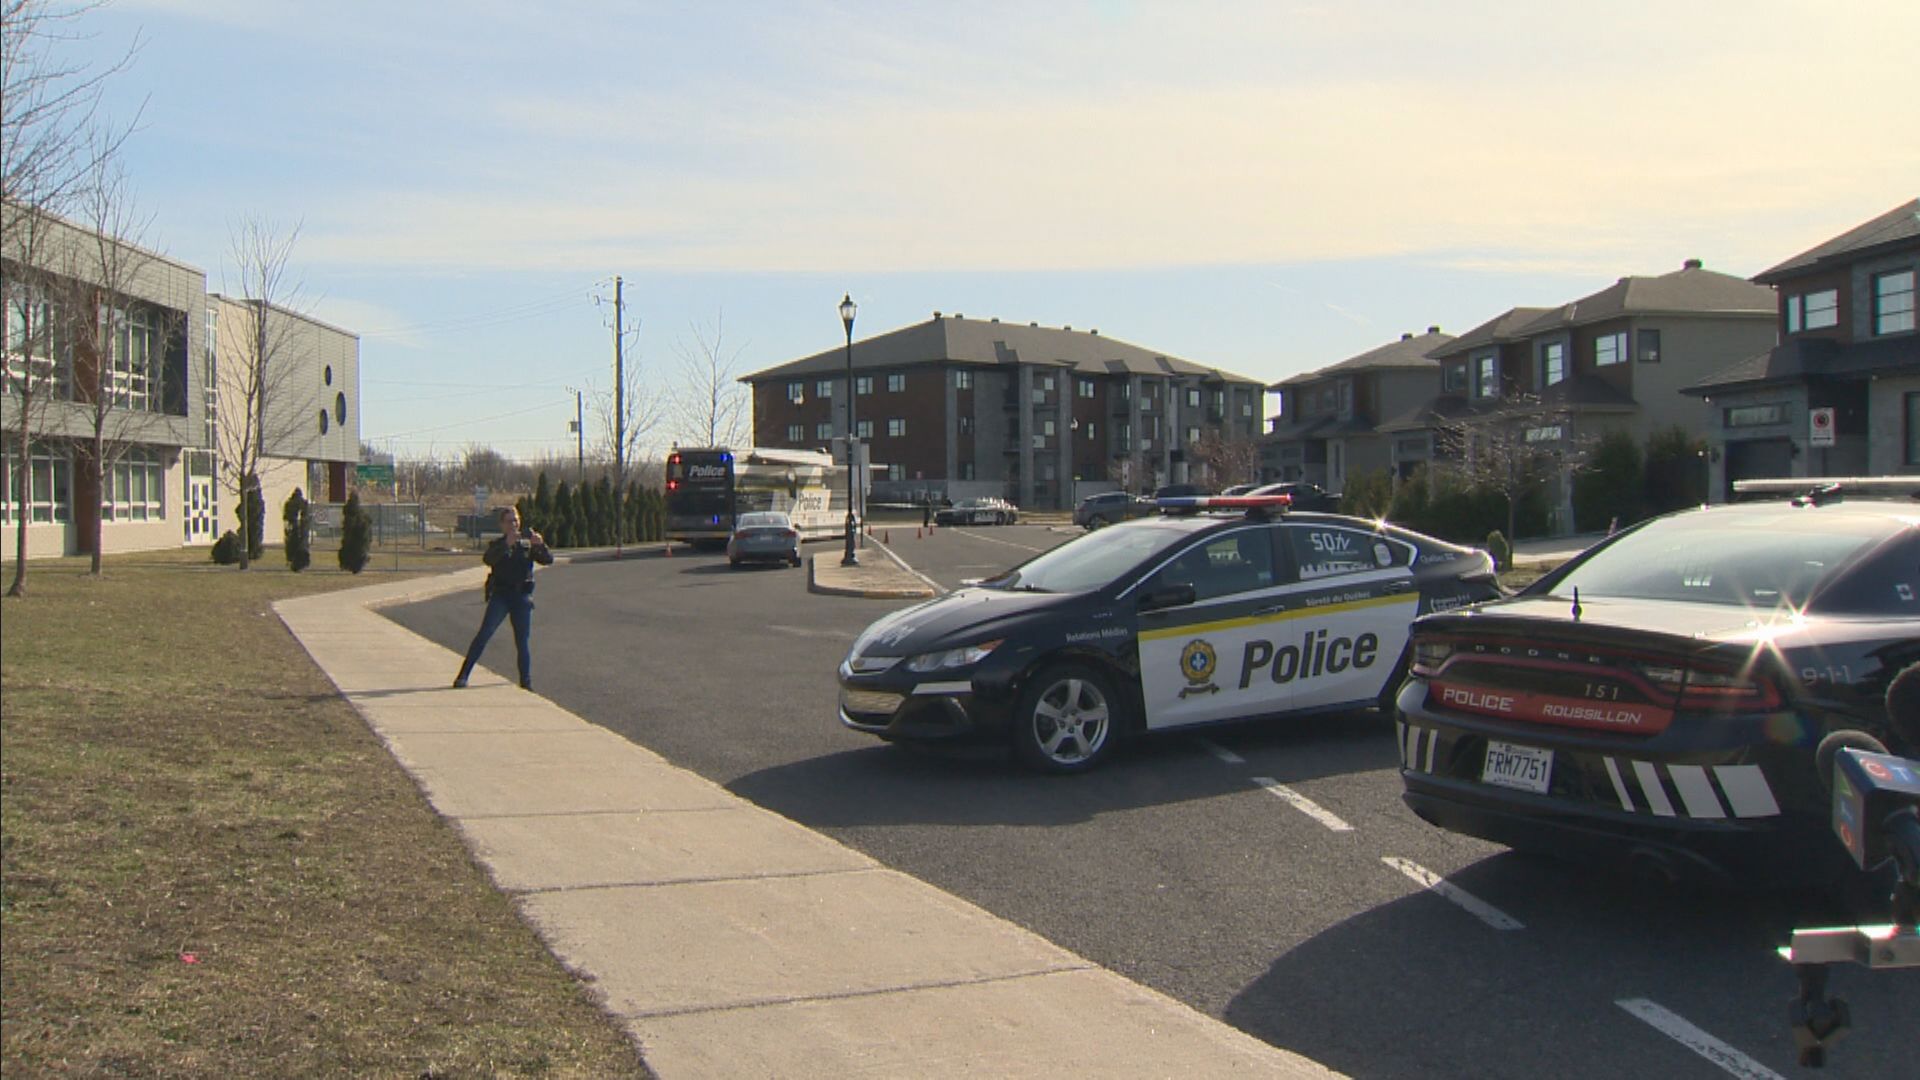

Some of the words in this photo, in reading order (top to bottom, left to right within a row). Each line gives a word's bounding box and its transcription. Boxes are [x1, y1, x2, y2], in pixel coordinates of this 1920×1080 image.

[689, 465, 726, 478] Police
[799, 493, 822, 512] Police
[1239, 629, 1378, 690] Police
[1443, 688, 1515, 713] POLICE
[1542, 704, 1643, 725] ROUSSILLON
[1486, 750, 1548, 783] FRM7751
